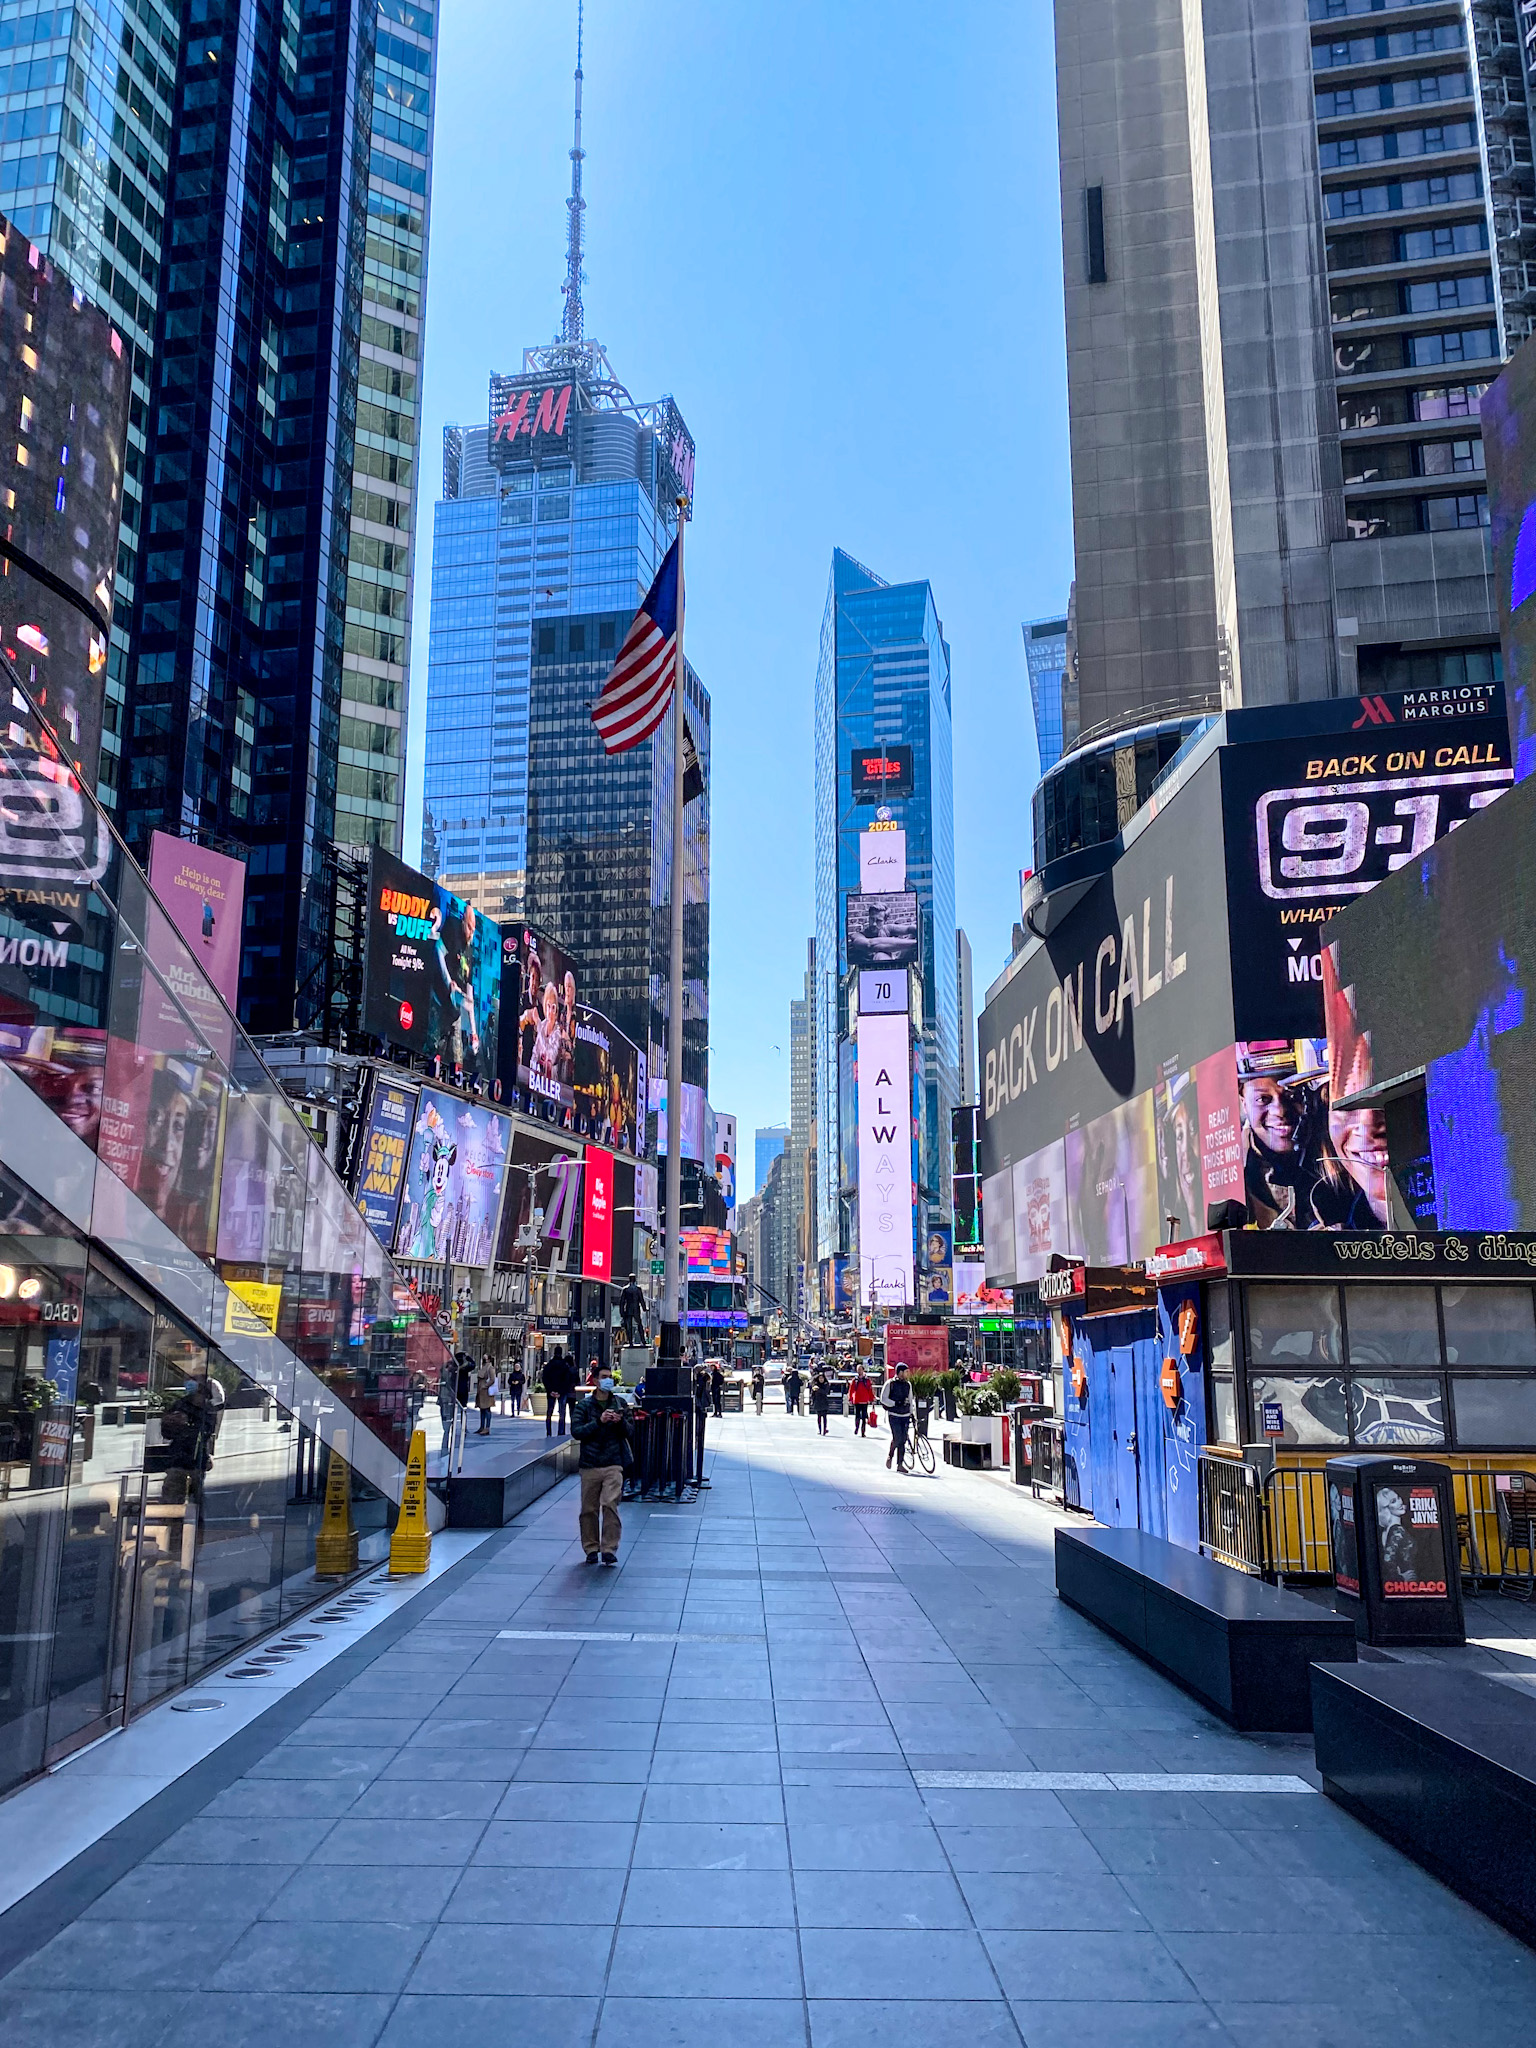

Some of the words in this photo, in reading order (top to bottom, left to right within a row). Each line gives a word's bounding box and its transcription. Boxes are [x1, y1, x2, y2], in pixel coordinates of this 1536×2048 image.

[494, 385, 572, 442] H&M
[1403, 685, 1496, 704] MARRIOTT
[1404, 700, 1486, 719] MARQUIS
[1305, 754, 1378, 780] BACK
[1385, 749, 1426, 772] ON
[1433, 743, 1501, 768] CALL
[868, 820, 898, 832] 2020
[867, 856, 898, 866] Clarks
[174, 875, 187, 887] the
[189, 880, 206, 897] way,
[207, 887, 226, 900] dear.
[181, 866, 201, 883] Help
[203, 873, 210, 883] is
[211, 879, 221, 888] on
[380, 887, 430, 919] BUDDY
[387, 913, 397, 926] VS
[396, 914, 433, 941] DUFF
[428, 907, 442, 940] 2
[407, 945, 417, 956] New
[529, 935, 537, 950] LG
[391, 955, 412, 970] Tonight
[503, 954, 516, 963] LG
[875, 982, 891, 999] 70
[984, 1002, 1038, 1121] BACK
[1045, 962, 1083, 1072] ON
[1094, 875, 1187, 1036] CALL
[400, 1007, 413, 1022] food
[528, 1069, 561, 1101] BALLER
[1208, 1106, 1230, 1129] READY
[370, 1132, 405, 1158] COME
[1205, 1134, 1214, 1150] TO
[1214, 1125, 1236, 1146] SERVE
[872, 1068, 898, 1233] ALWAYS
[1203, 1149, 1224, 1170] THOSE
[1224, 1144, 1240, 1163] WHO
[465, 1159, 482, 1178] Disney
[482, 1169, 494, 1180] store
[1207, 1168, 1228, 1189] SERVE
[1228, 1165, 1239, 1183] US
[362, 1171, 400, 1196] AWAY
[595, 1177, 604, 1195] Big
[592, 1193, 606, 1211] Apple
[1333, 1234, 1436, 1261] wafels
[1443, 1237, 1469, 1261] &
[490, 1270, 538, 1308] FOREVR
[868, 1277, 906, 1289] Clarks
[1038, 1273, 1051, 1301] HOT
[1052, 1270, 1072, 1297] DOGS
[1409, 1497, 1438, 1511] ERIKA
[1410, 1512, 1438, 1524] JAYNE
[1384, 1581, 1447, 1593] CHICAGO
